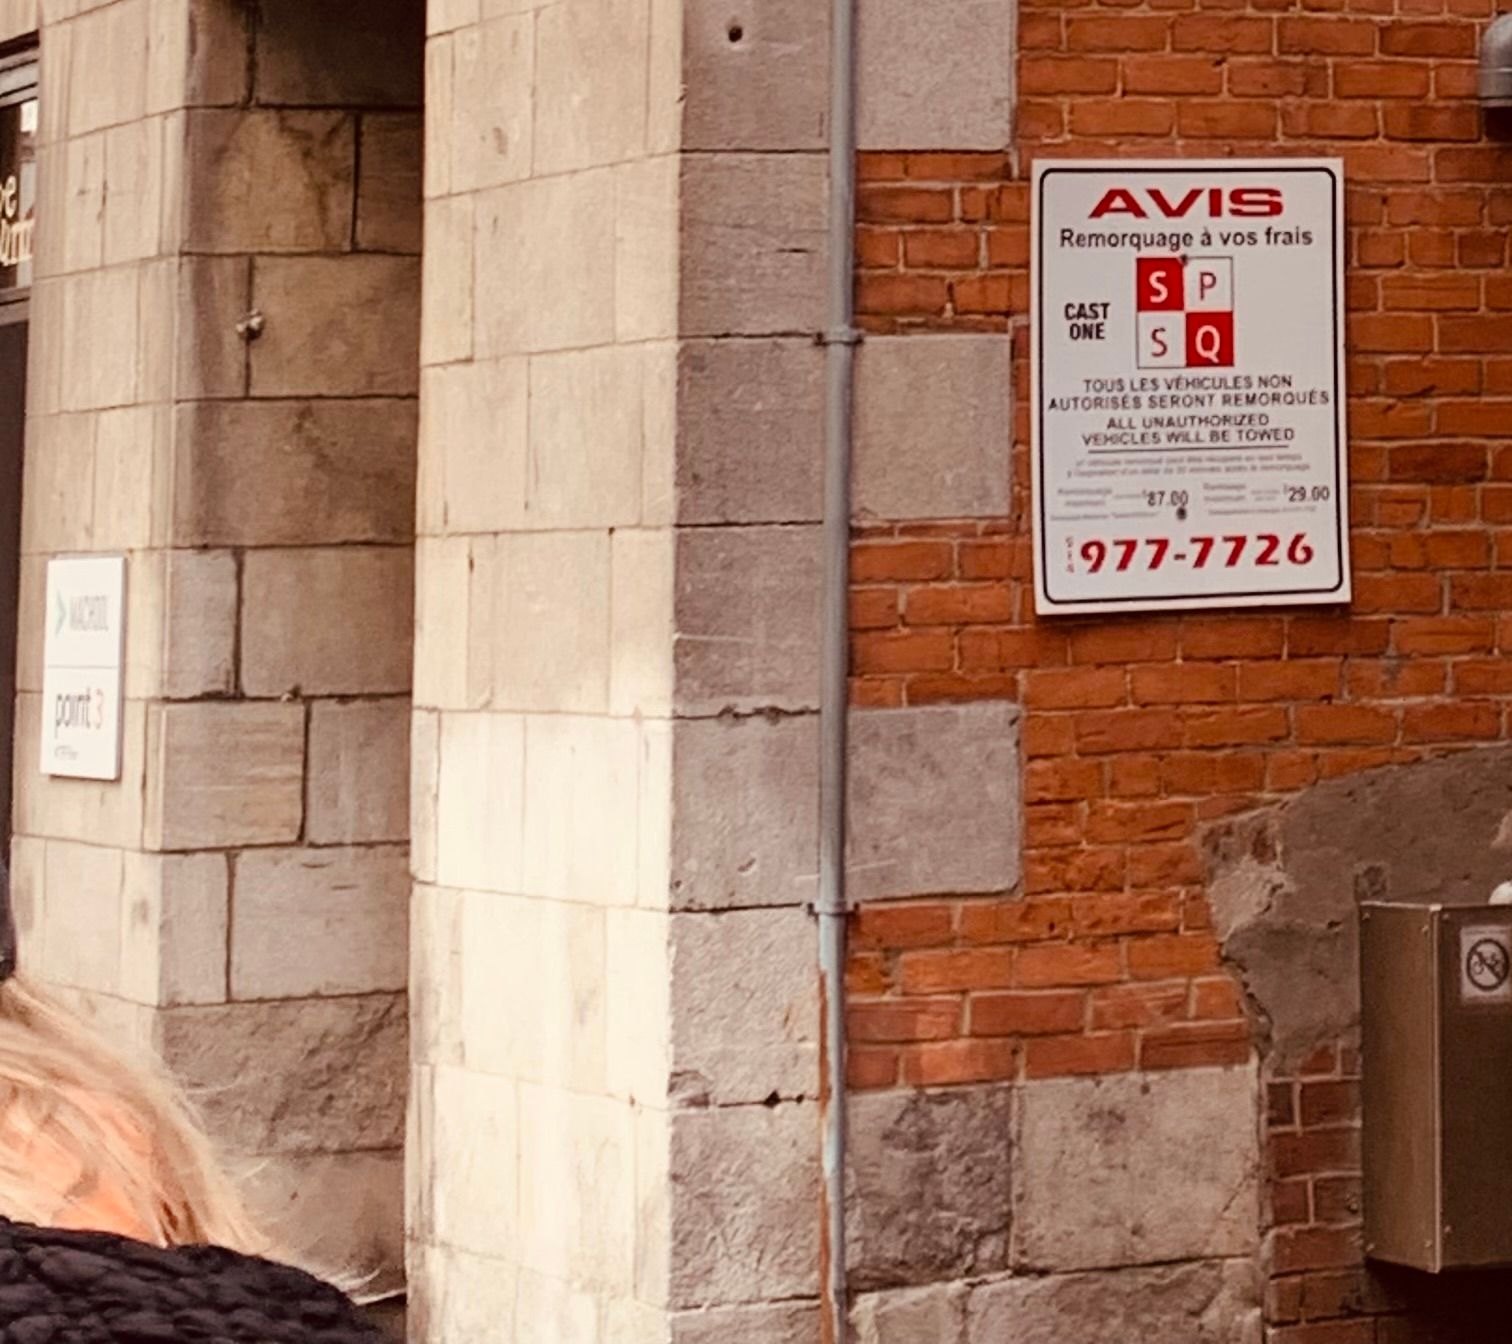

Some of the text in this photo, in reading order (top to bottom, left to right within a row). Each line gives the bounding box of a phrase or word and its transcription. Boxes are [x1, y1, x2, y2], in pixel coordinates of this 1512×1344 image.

[1088, 188, 1284, 218] AVIS
[1060, 226, 1313, 251] Remorquage à vos frais
[1064, 303, 1110, 320] CAST
[1070, 323, 1105, 340] ONE
[1084, 378, 1125, 393] TOUS
[1130, 377, 1159, 392] LES
[1258, 375, 1293, 388] NON
[1148, 392, 1214, 409] SERONT
[1107, 414, 1269, 430] ALL UNAUTHORIZED
[1082, 428, 1295, 446] VEHICLES WILL BE TOWED
[1080, 532, 1314, 574] 977-7726
